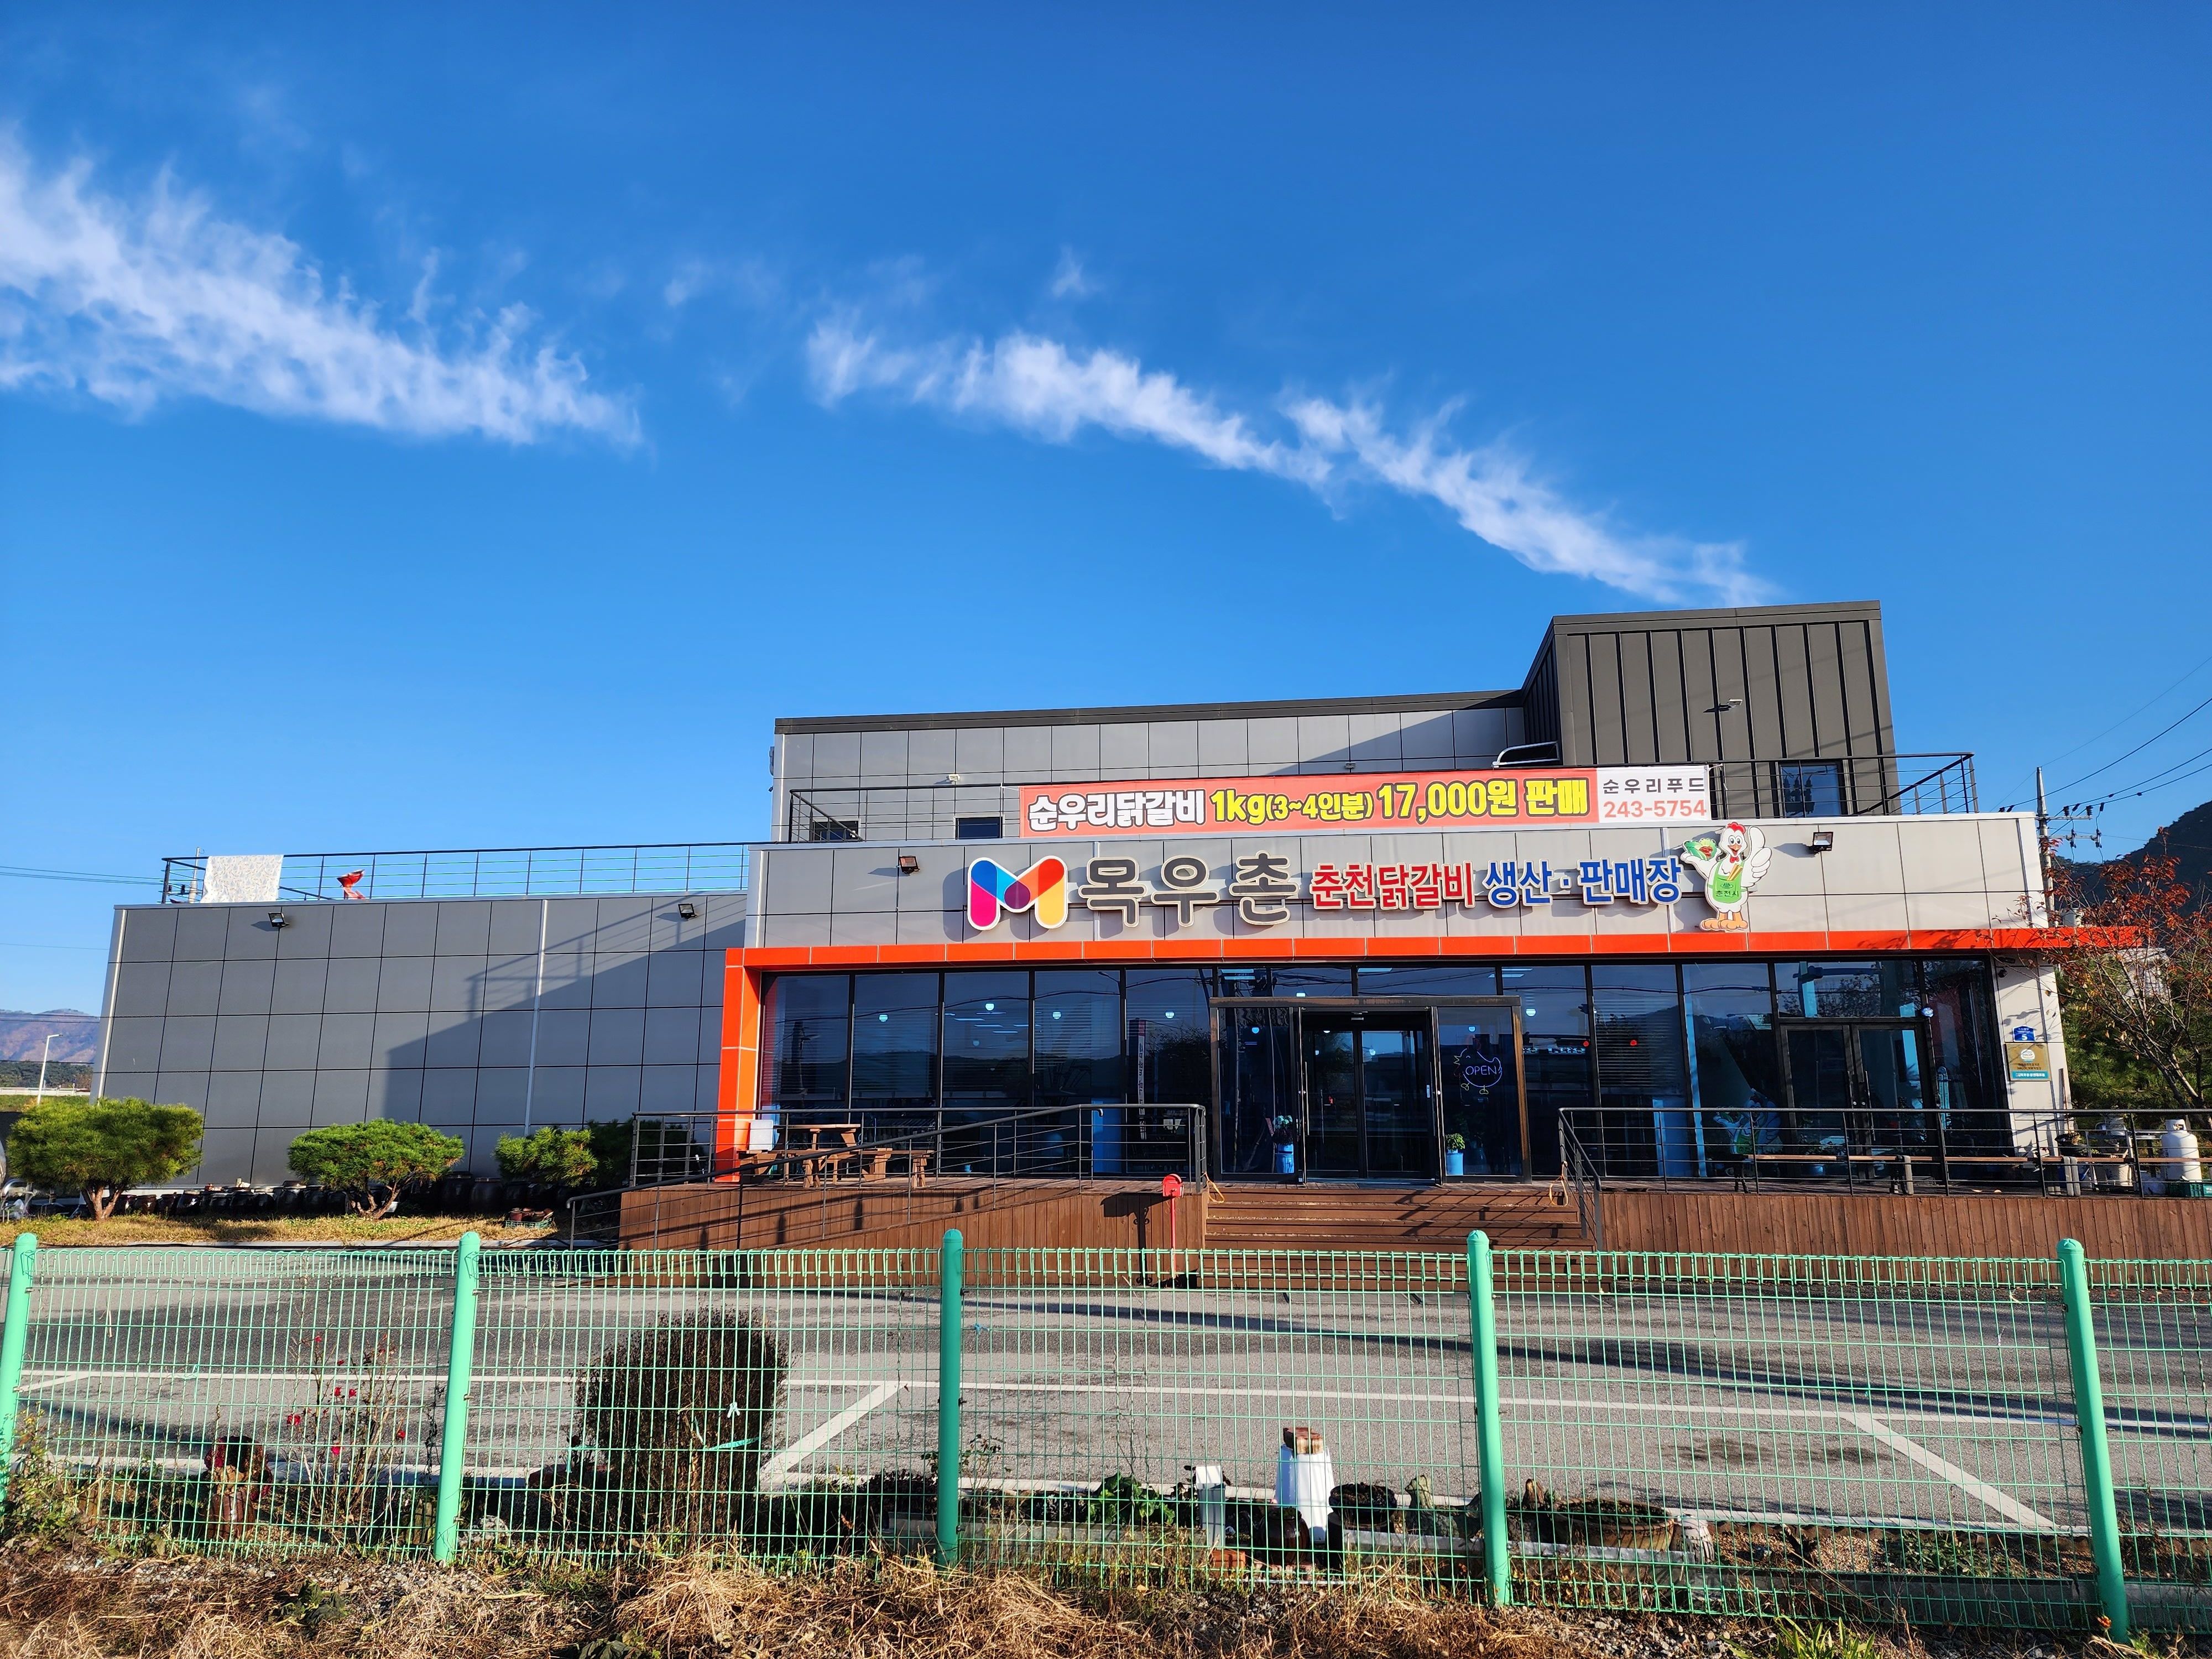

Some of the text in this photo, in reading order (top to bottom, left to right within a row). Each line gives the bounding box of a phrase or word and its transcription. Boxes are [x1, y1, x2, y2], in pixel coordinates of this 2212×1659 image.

[1603, 777, 1705, 795] 순우리푸드
[1028, 790, 1206, 830] 순우리닭갈비
[1378, 778, 1519, 824] 17,000원
[1525, 777, 1589, 817] 판매
[1603, 800, 1707, 818] 243-5754
[1078, 850, 1299, 927] 목우촌
[1310, 860, 1475, 911] 춘천닭갈비
[1465, 1065, 1498, 1076] OPEN
